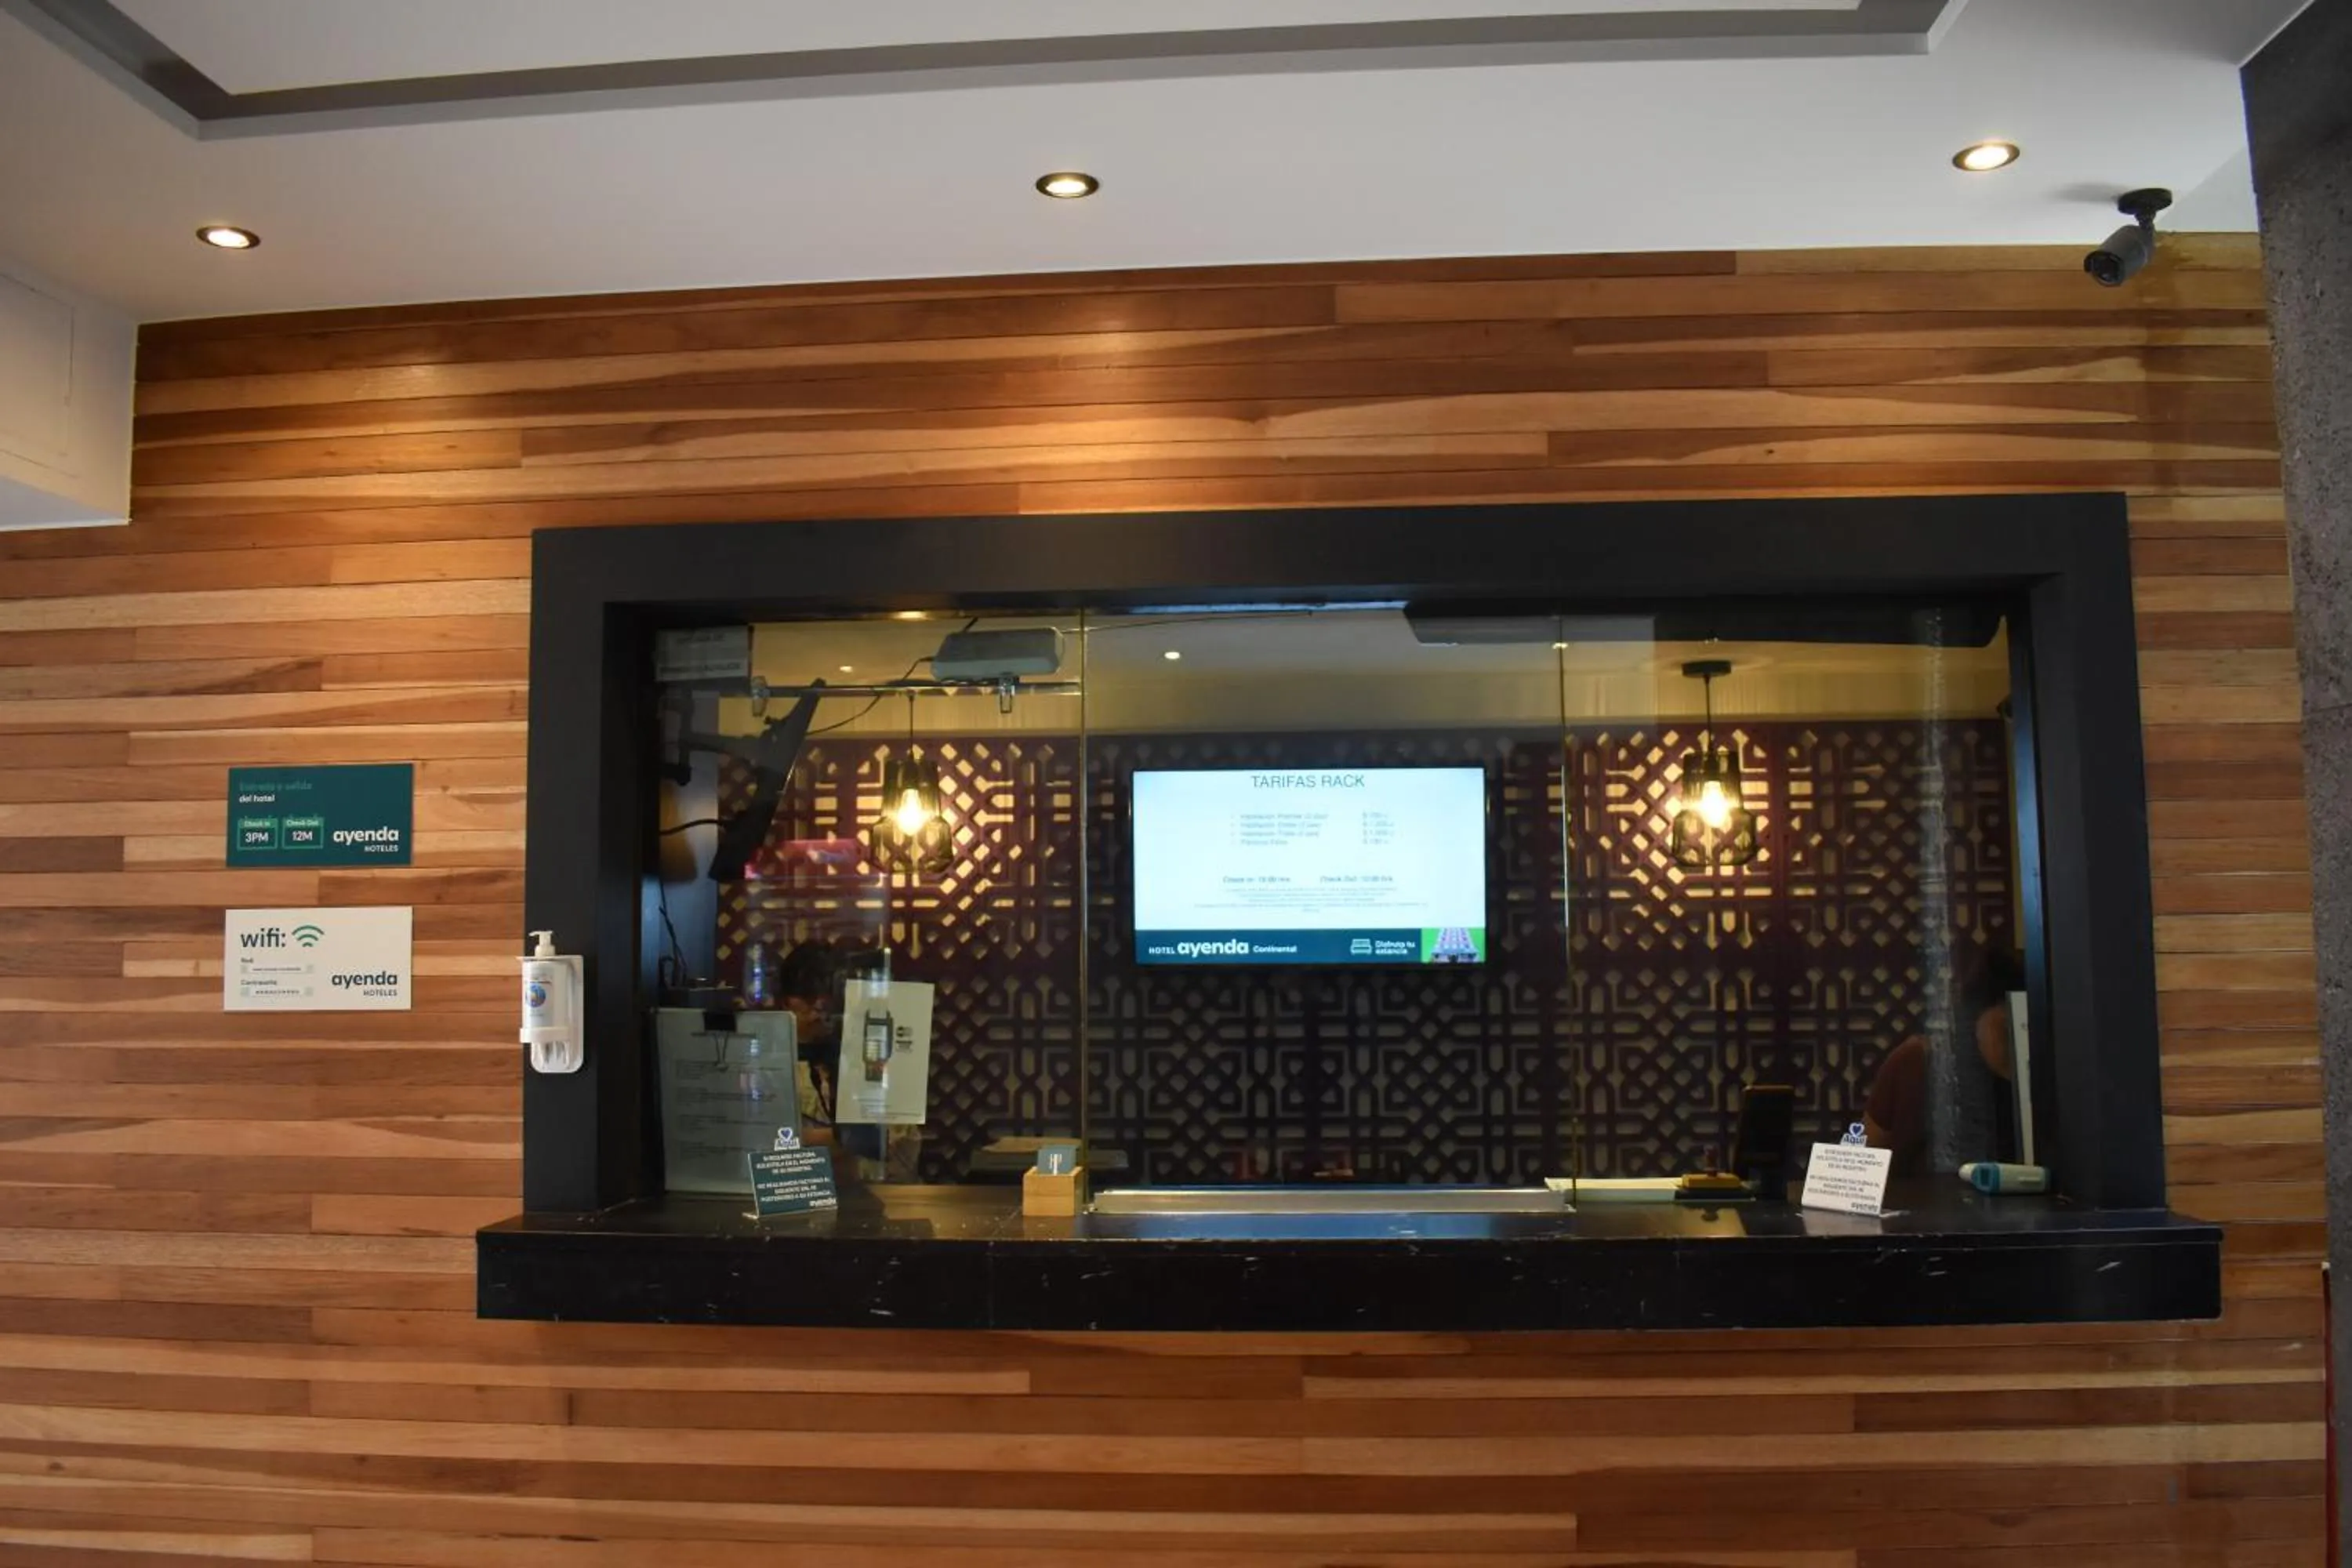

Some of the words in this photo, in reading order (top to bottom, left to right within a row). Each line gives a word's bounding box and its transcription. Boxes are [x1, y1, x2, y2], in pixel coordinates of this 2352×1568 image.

[1251, 775, 1316, 788] TARIFAS
[1321, 775, 1366, 788] RACK
[239, 794, 252, 804] del
[253, 794, 275, 803] hotel
[245, 830, 269, 844] 3PM
[292, 830, 313, 842] 12M
[332, 826, 399, 846] ayenda
[240, 927, 286, 948] wifi:
[1178, 938, 1249, 958] ayenda
[1252, 945, 1298, 954] Continental
[331, 971, 398, 989] ayenda
